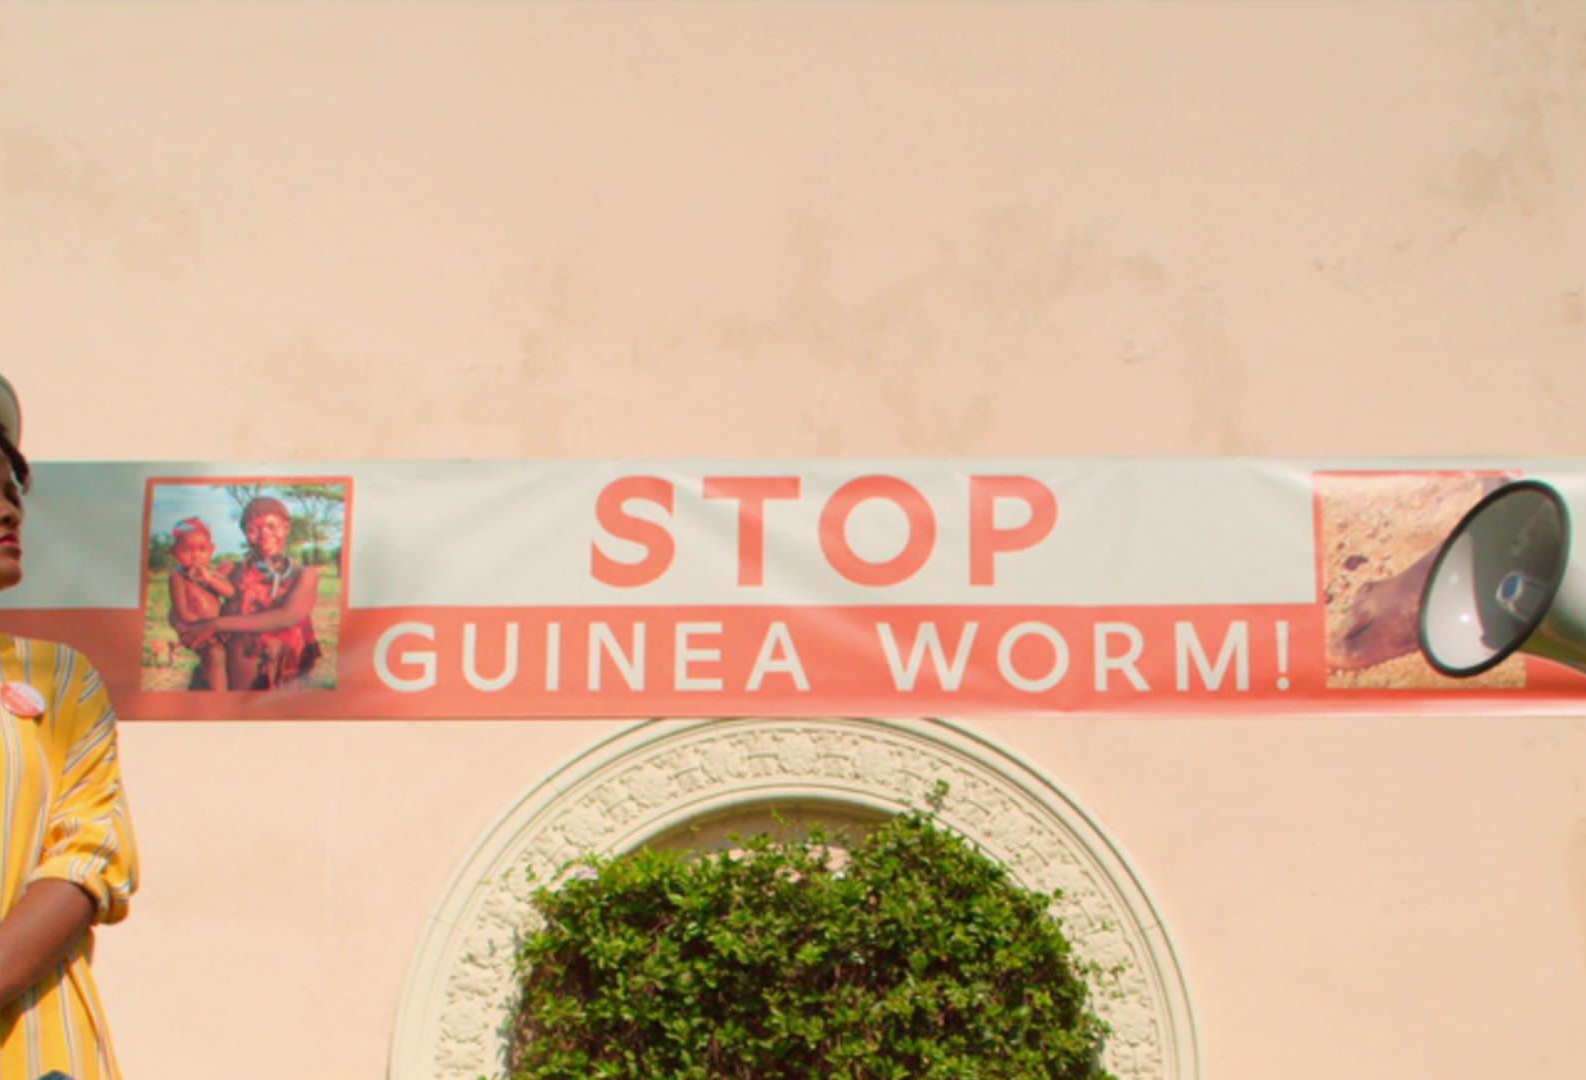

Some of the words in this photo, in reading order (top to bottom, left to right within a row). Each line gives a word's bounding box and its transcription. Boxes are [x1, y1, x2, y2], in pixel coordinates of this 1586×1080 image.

[589, 473, 1060, 591] STOP
[372, 621, 812, 694] GUINEA
[877, 620, 1291, 693] WORM!
